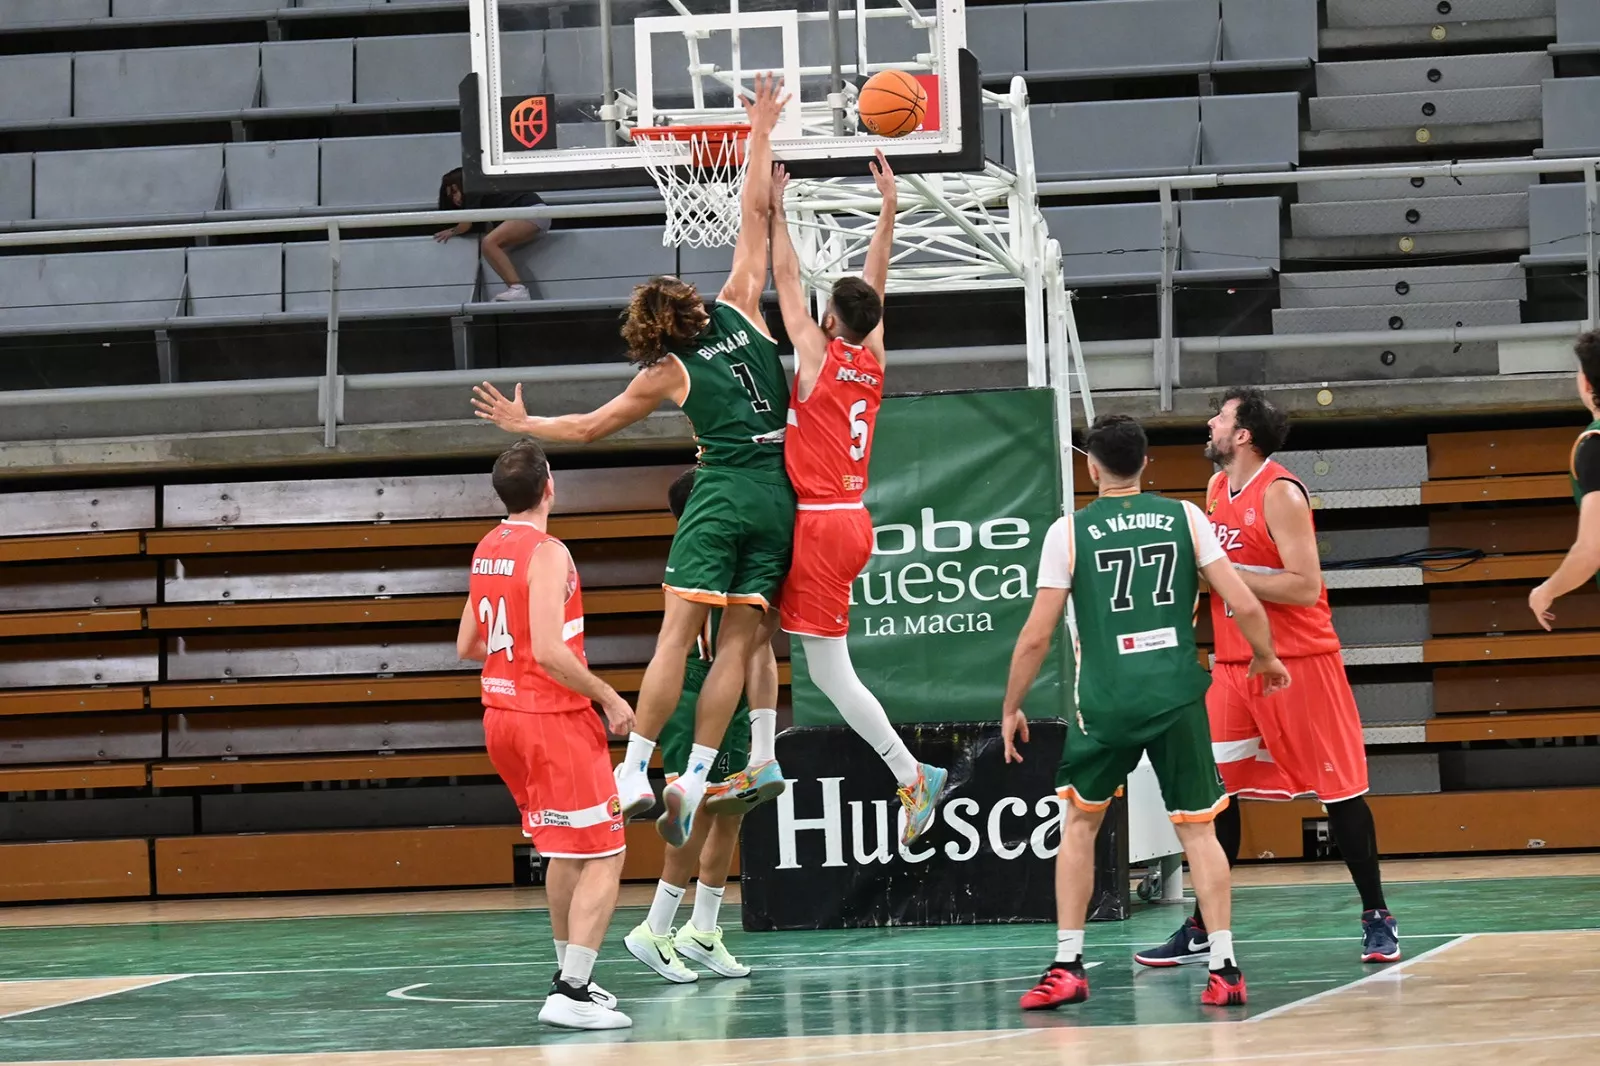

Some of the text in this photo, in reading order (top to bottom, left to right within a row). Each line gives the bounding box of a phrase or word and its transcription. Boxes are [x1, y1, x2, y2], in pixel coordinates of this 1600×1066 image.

[729, 362, 772, 414] 1
[872, 507, 1031, 556] obe
[1087, 512, 1175, 540] G. VÁZQUEZ
[848, 560, 1032, 606] uesca
[1094, 541, 1178, 613] 77
[717, 751, 730, 773] 4
[775, 777, 1069, 870] Huesca
